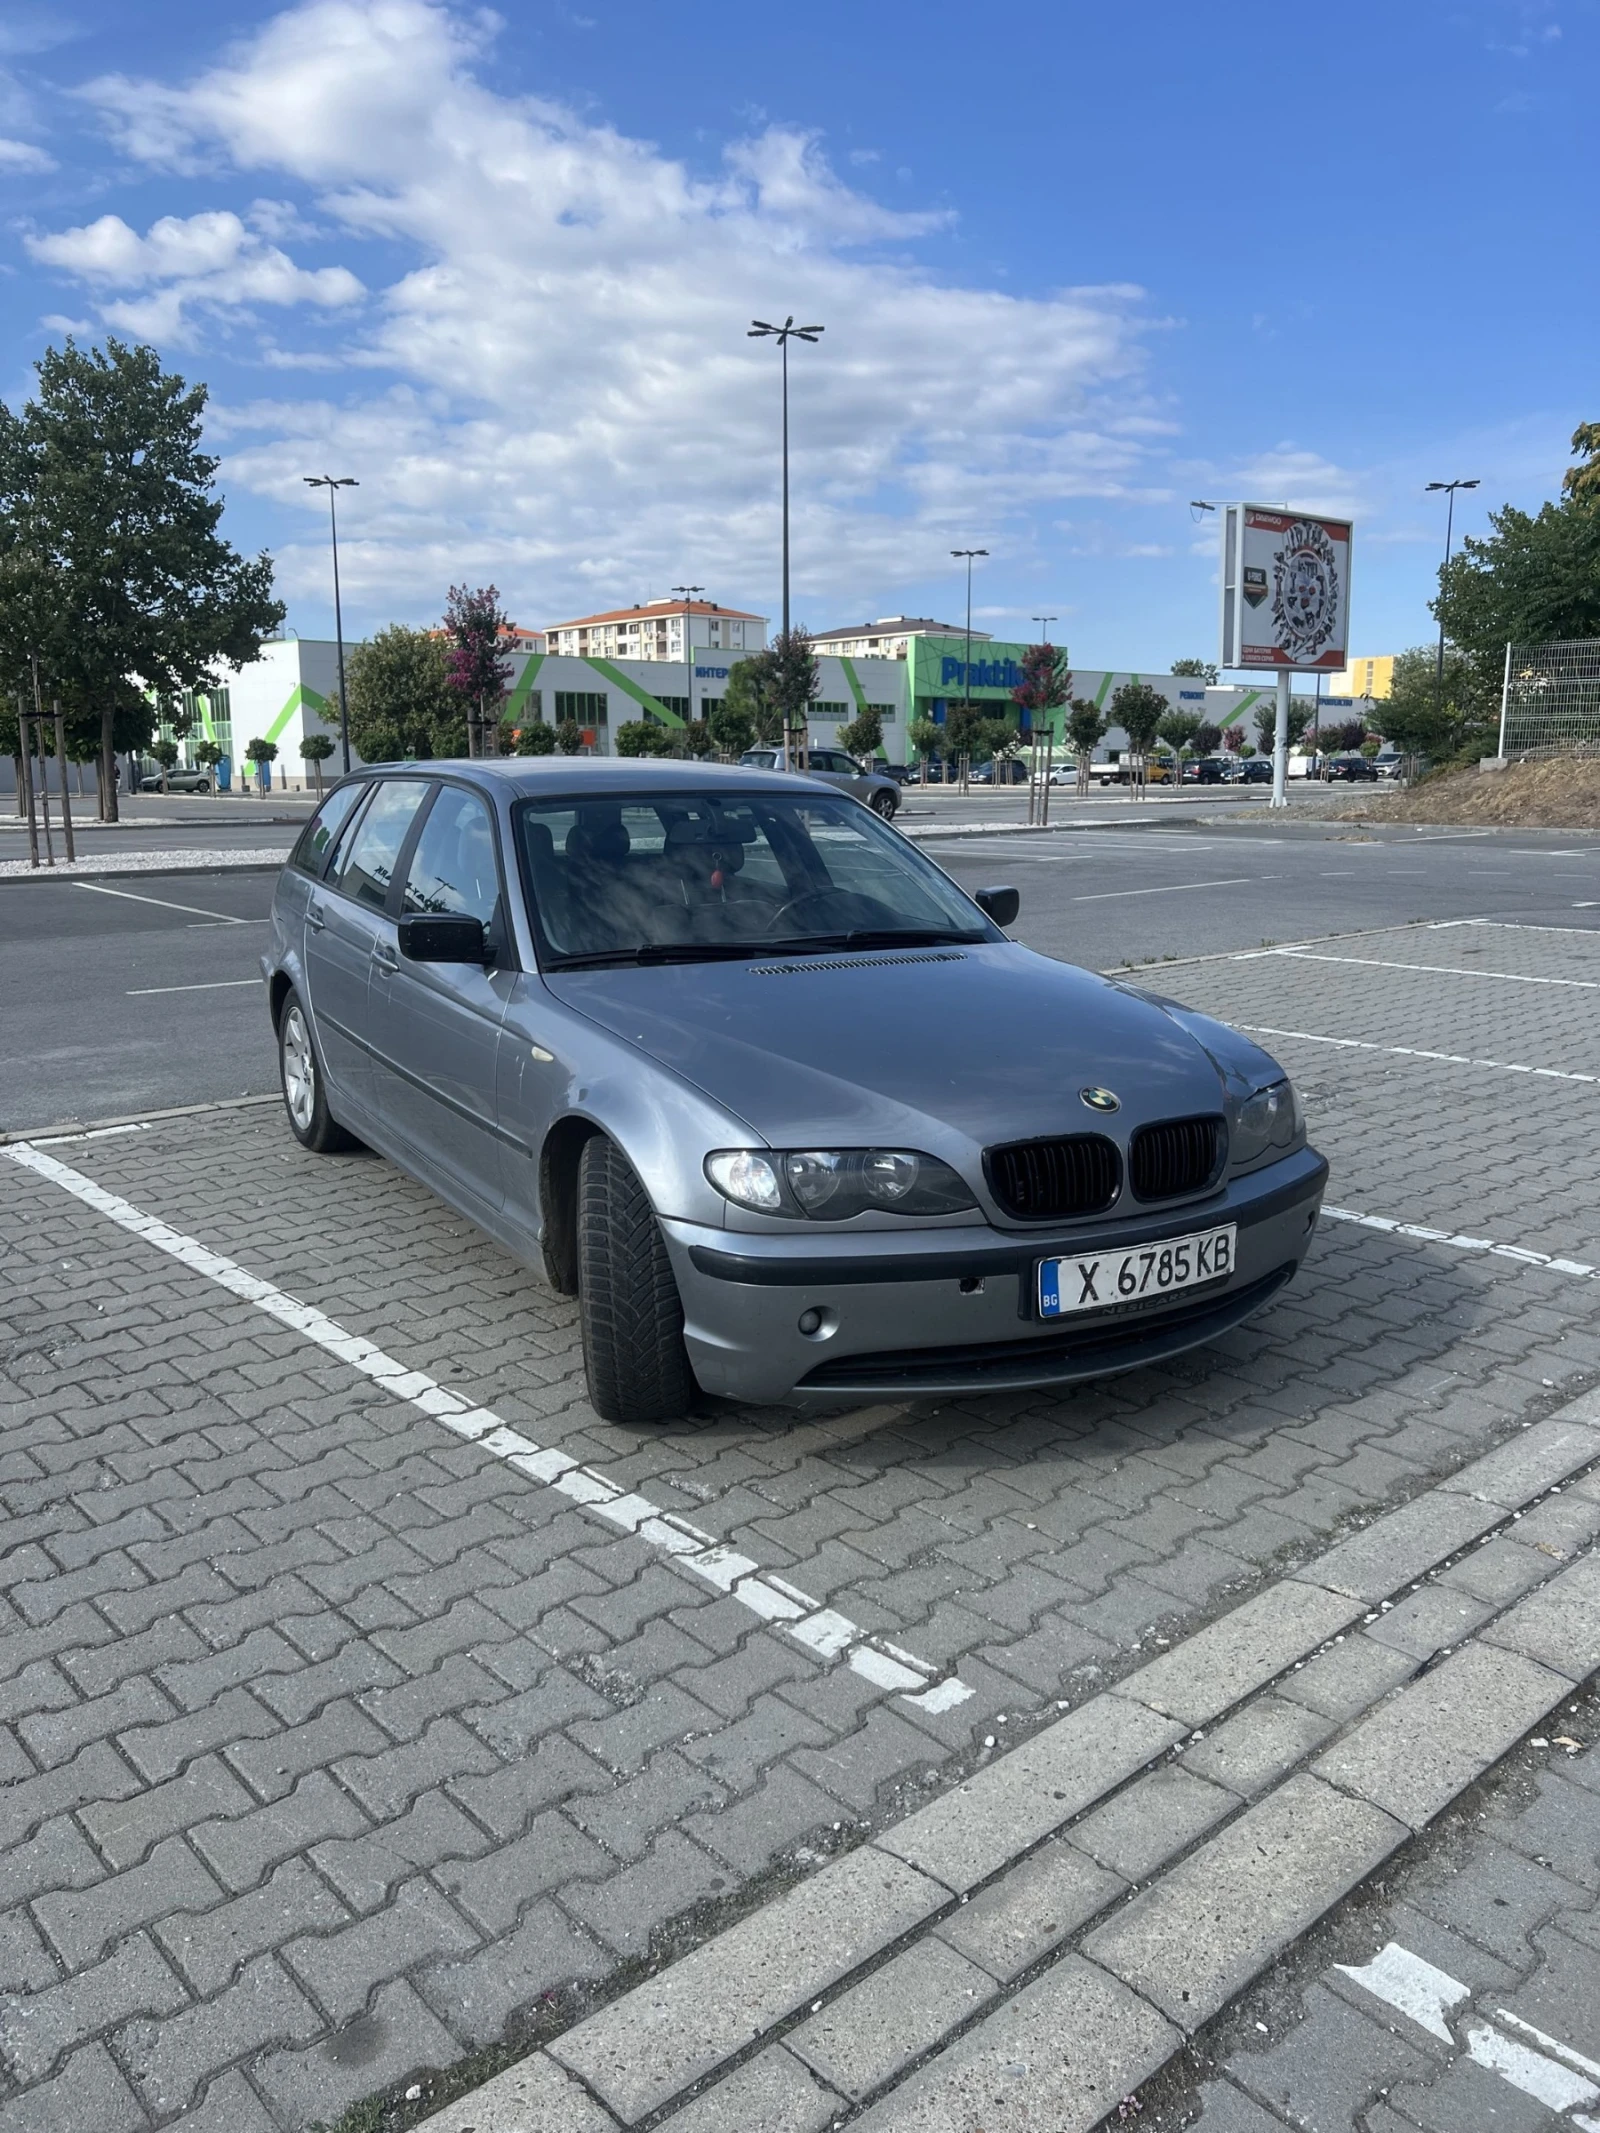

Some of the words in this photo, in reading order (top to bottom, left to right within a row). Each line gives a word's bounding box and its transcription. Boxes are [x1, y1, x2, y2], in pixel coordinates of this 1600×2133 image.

[695, 666, 729, 679] ИНТЕР
[942, 656, 1027, 687] Praktik
[1078, 1261, 1100, 1304] X
[1117, 1244, 1191, 1296] 6785
[1196, 1234, 1230, 1278] KB
[1043, 1294, 1058, 1307] BG
